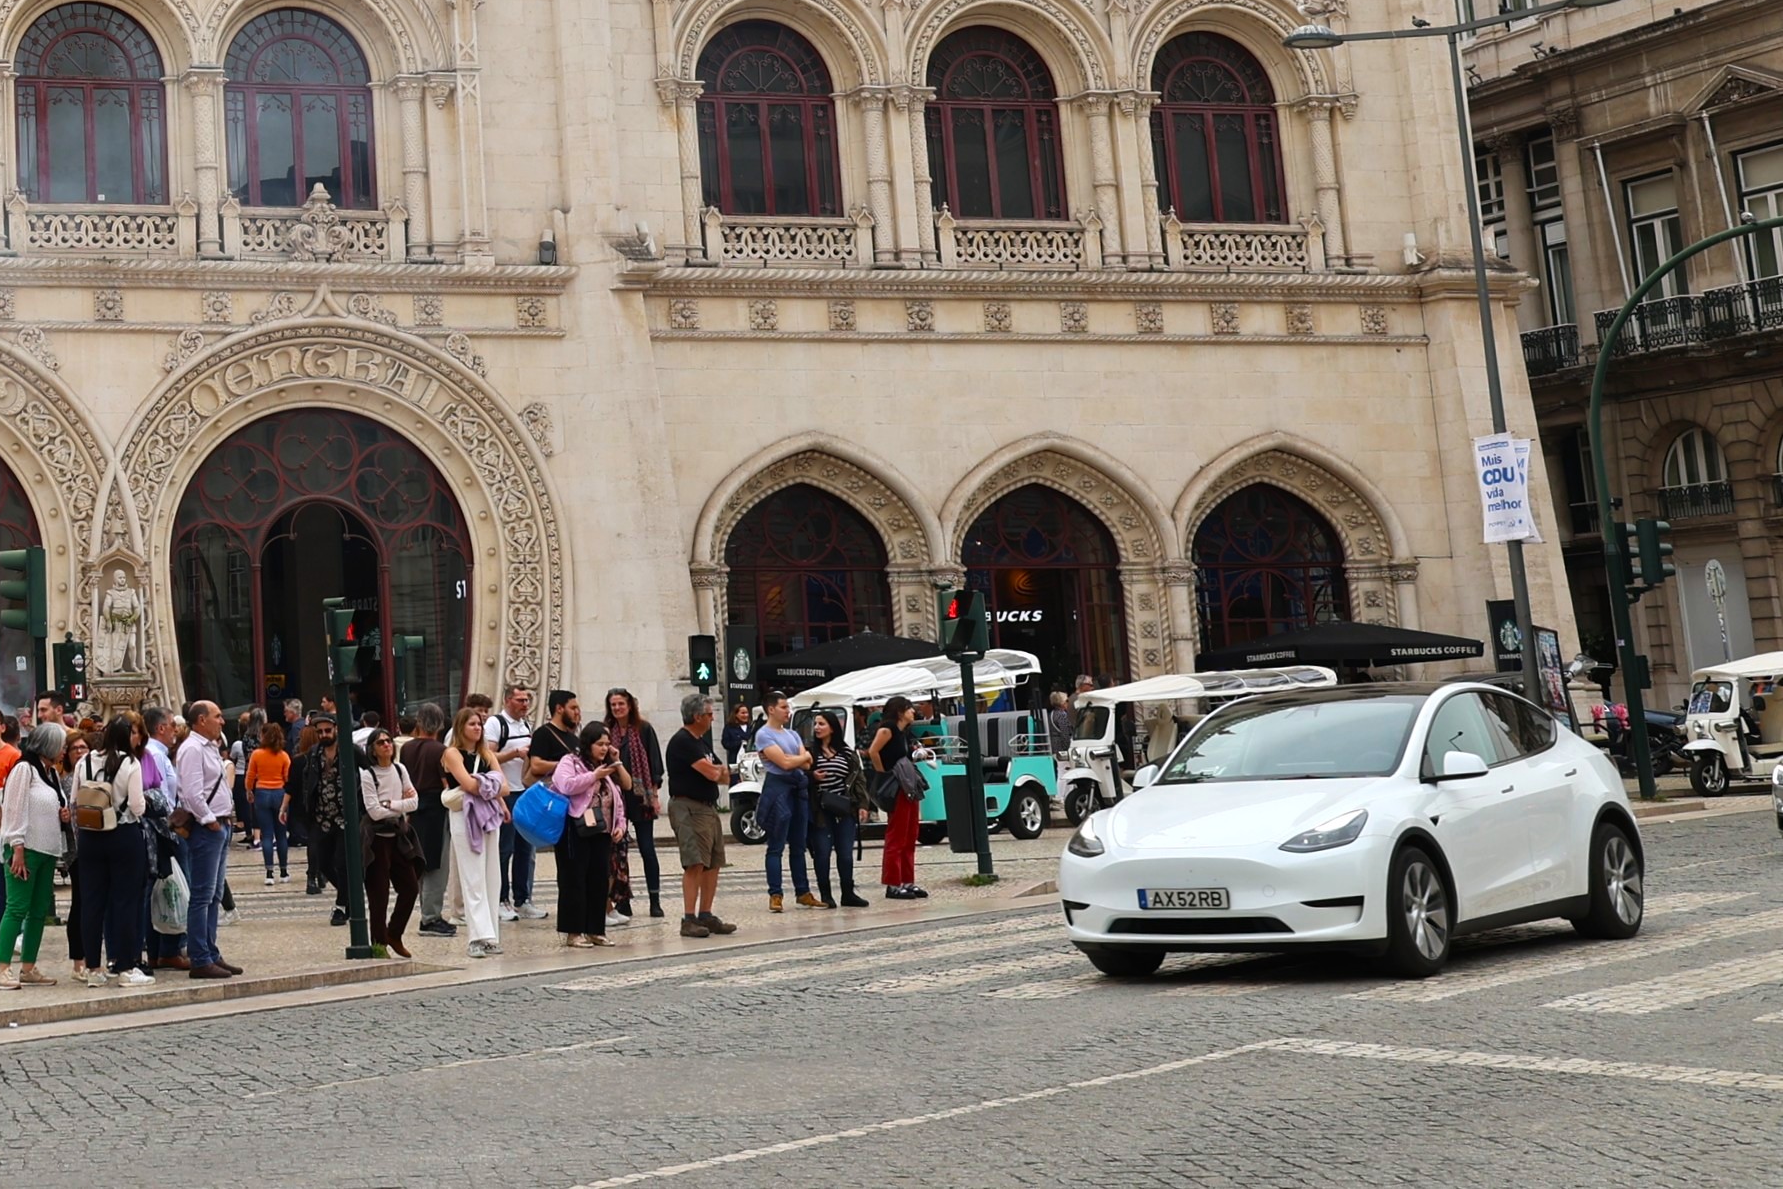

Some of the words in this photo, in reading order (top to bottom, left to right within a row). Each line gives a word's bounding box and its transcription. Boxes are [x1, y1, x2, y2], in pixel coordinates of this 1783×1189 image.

[1482, 466, 1515, 485] CDU
[1486, 487, 1504, 499] vida
[1488, 499, 1522, 512] melhor
[1390, 647, 1443, 656] STARBUCKS
[1443, 646, 1477, 654] COFFEE
[1152, 891, 1223, 907] AX52RB
